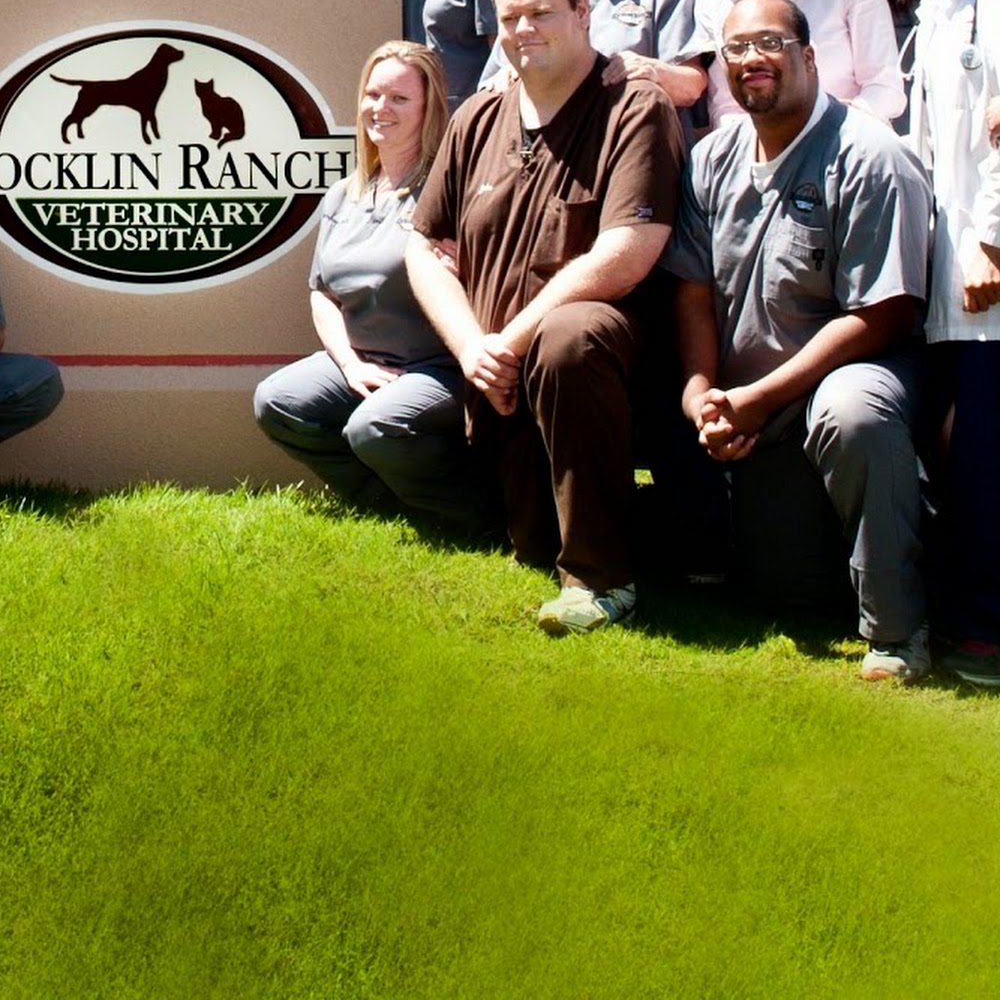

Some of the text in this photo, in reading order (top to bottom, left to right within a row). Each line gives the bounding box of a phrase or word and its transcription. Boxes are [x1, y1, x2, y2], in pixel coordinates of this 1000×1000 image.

[178, 143, 352, 191] RANCH
[32, 202, 270, 227] VETERINARY
[70, 226, 233, 252] HOSPITAL
